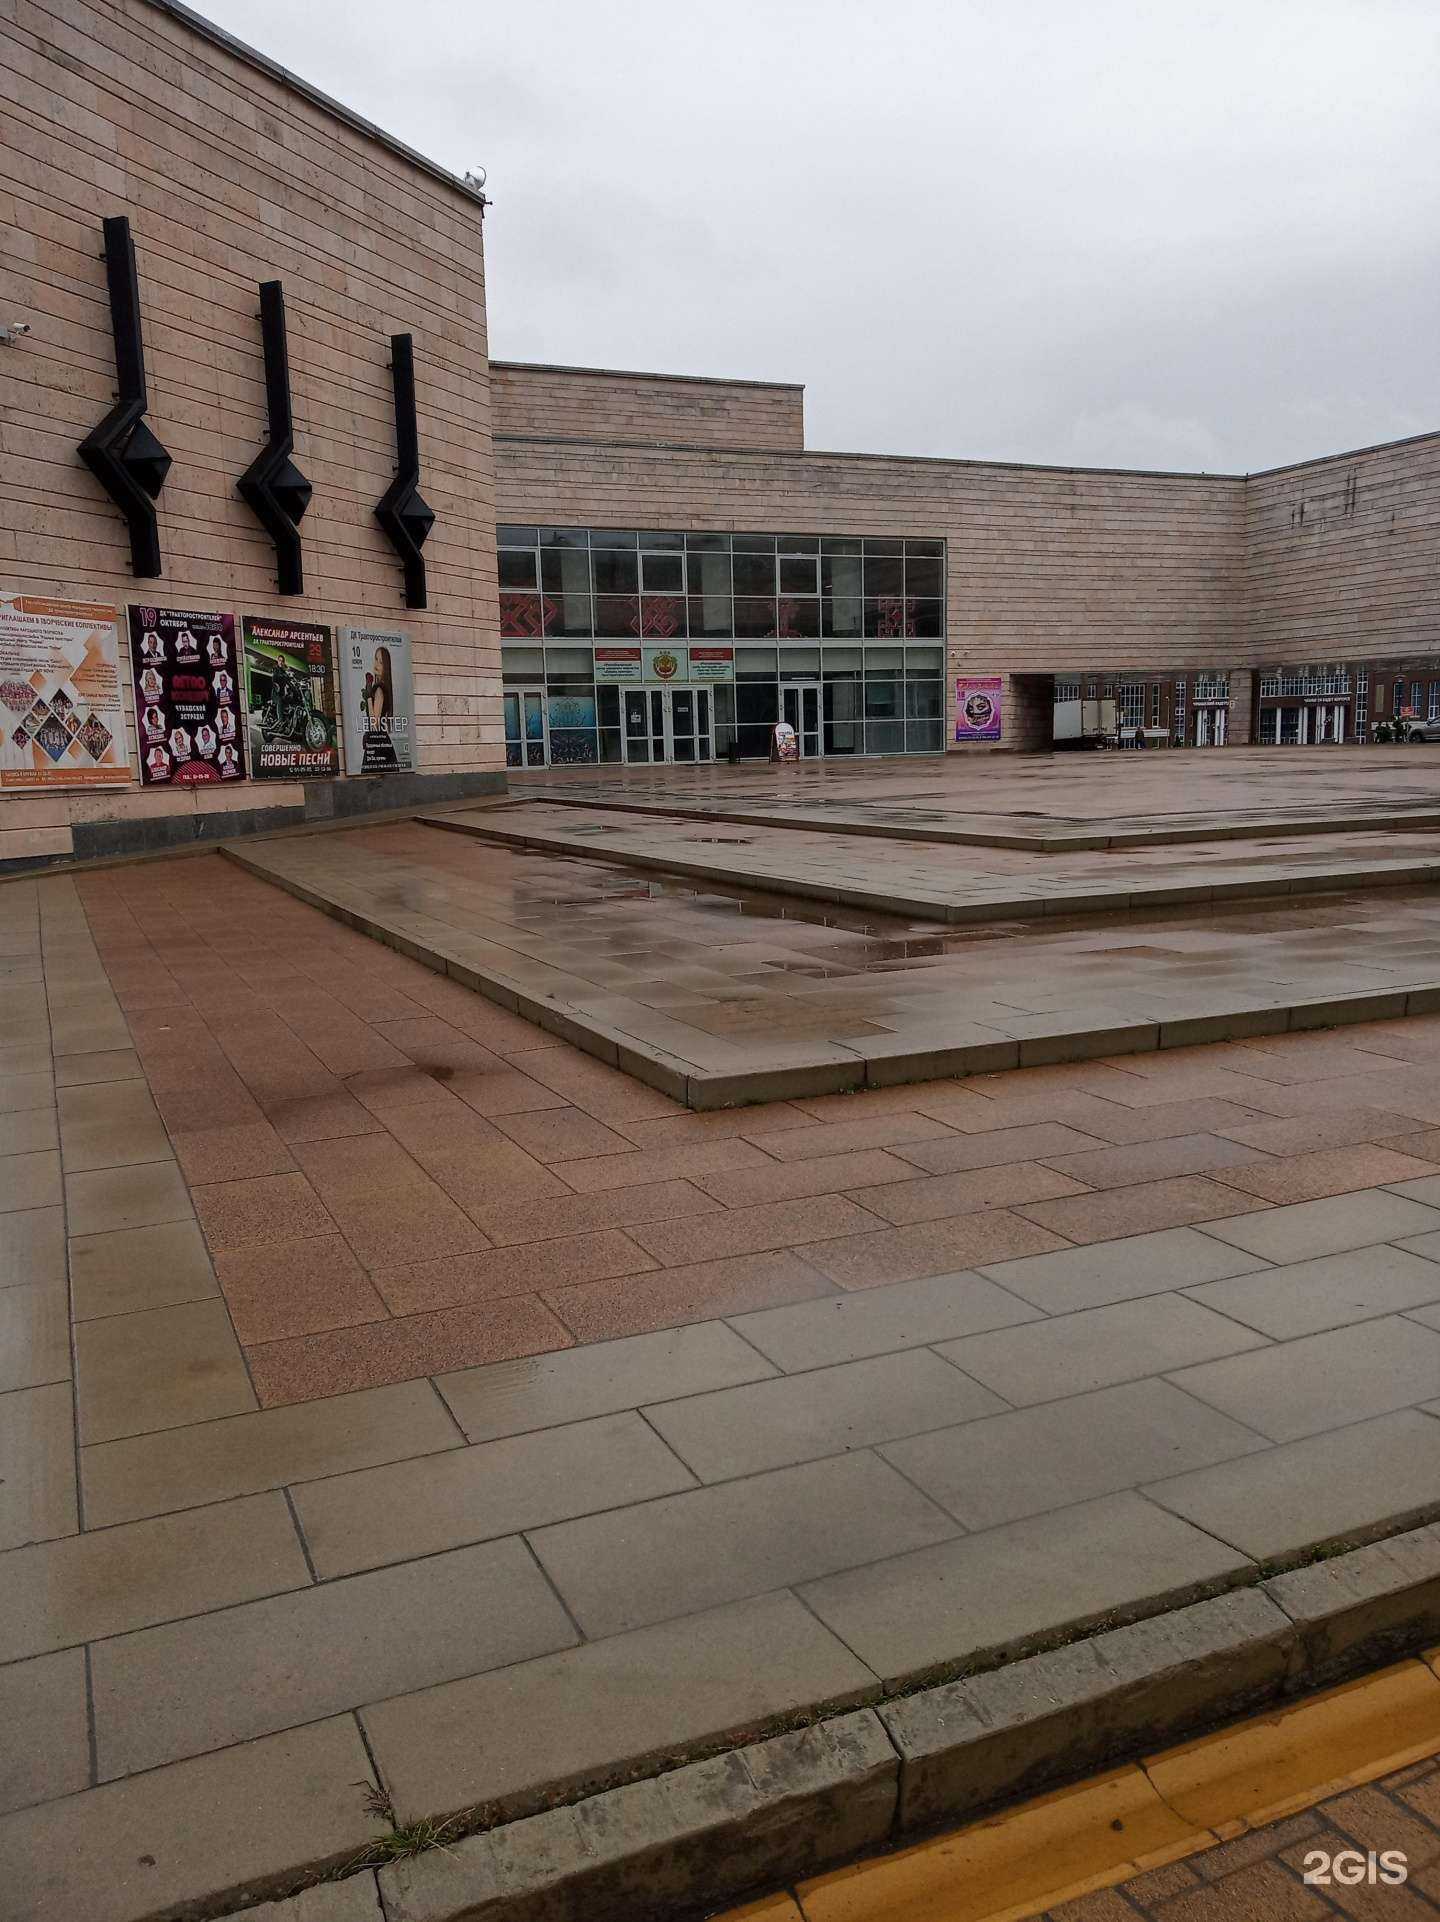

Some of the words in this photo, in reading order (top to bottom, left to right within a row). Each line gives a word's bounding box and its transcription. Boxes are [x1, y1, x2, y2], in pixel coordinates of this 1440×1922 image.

[140, 608, 157, 627] 19
[160, 619, 189, 629] ОКТЯБРЯ
[251, 625, 289, 639] АЛЕКСАНДР
[289, 631, 324, 642] АРСЕНТЬЕВ
[352, 645, 361, 658] 10
[175, 703, 206, 712] ЧУВАШСКОЙ
[180, 712, 205, 720] ЭСТРАДЫ
[357, 715, 408, 733] LERISTEP
[261, 744, 302, 753] СОВЕРШЕННО
[260, 753, 297, 767] НОВЫЕ
[299, 751, 332, 766] ПЕСНИ
